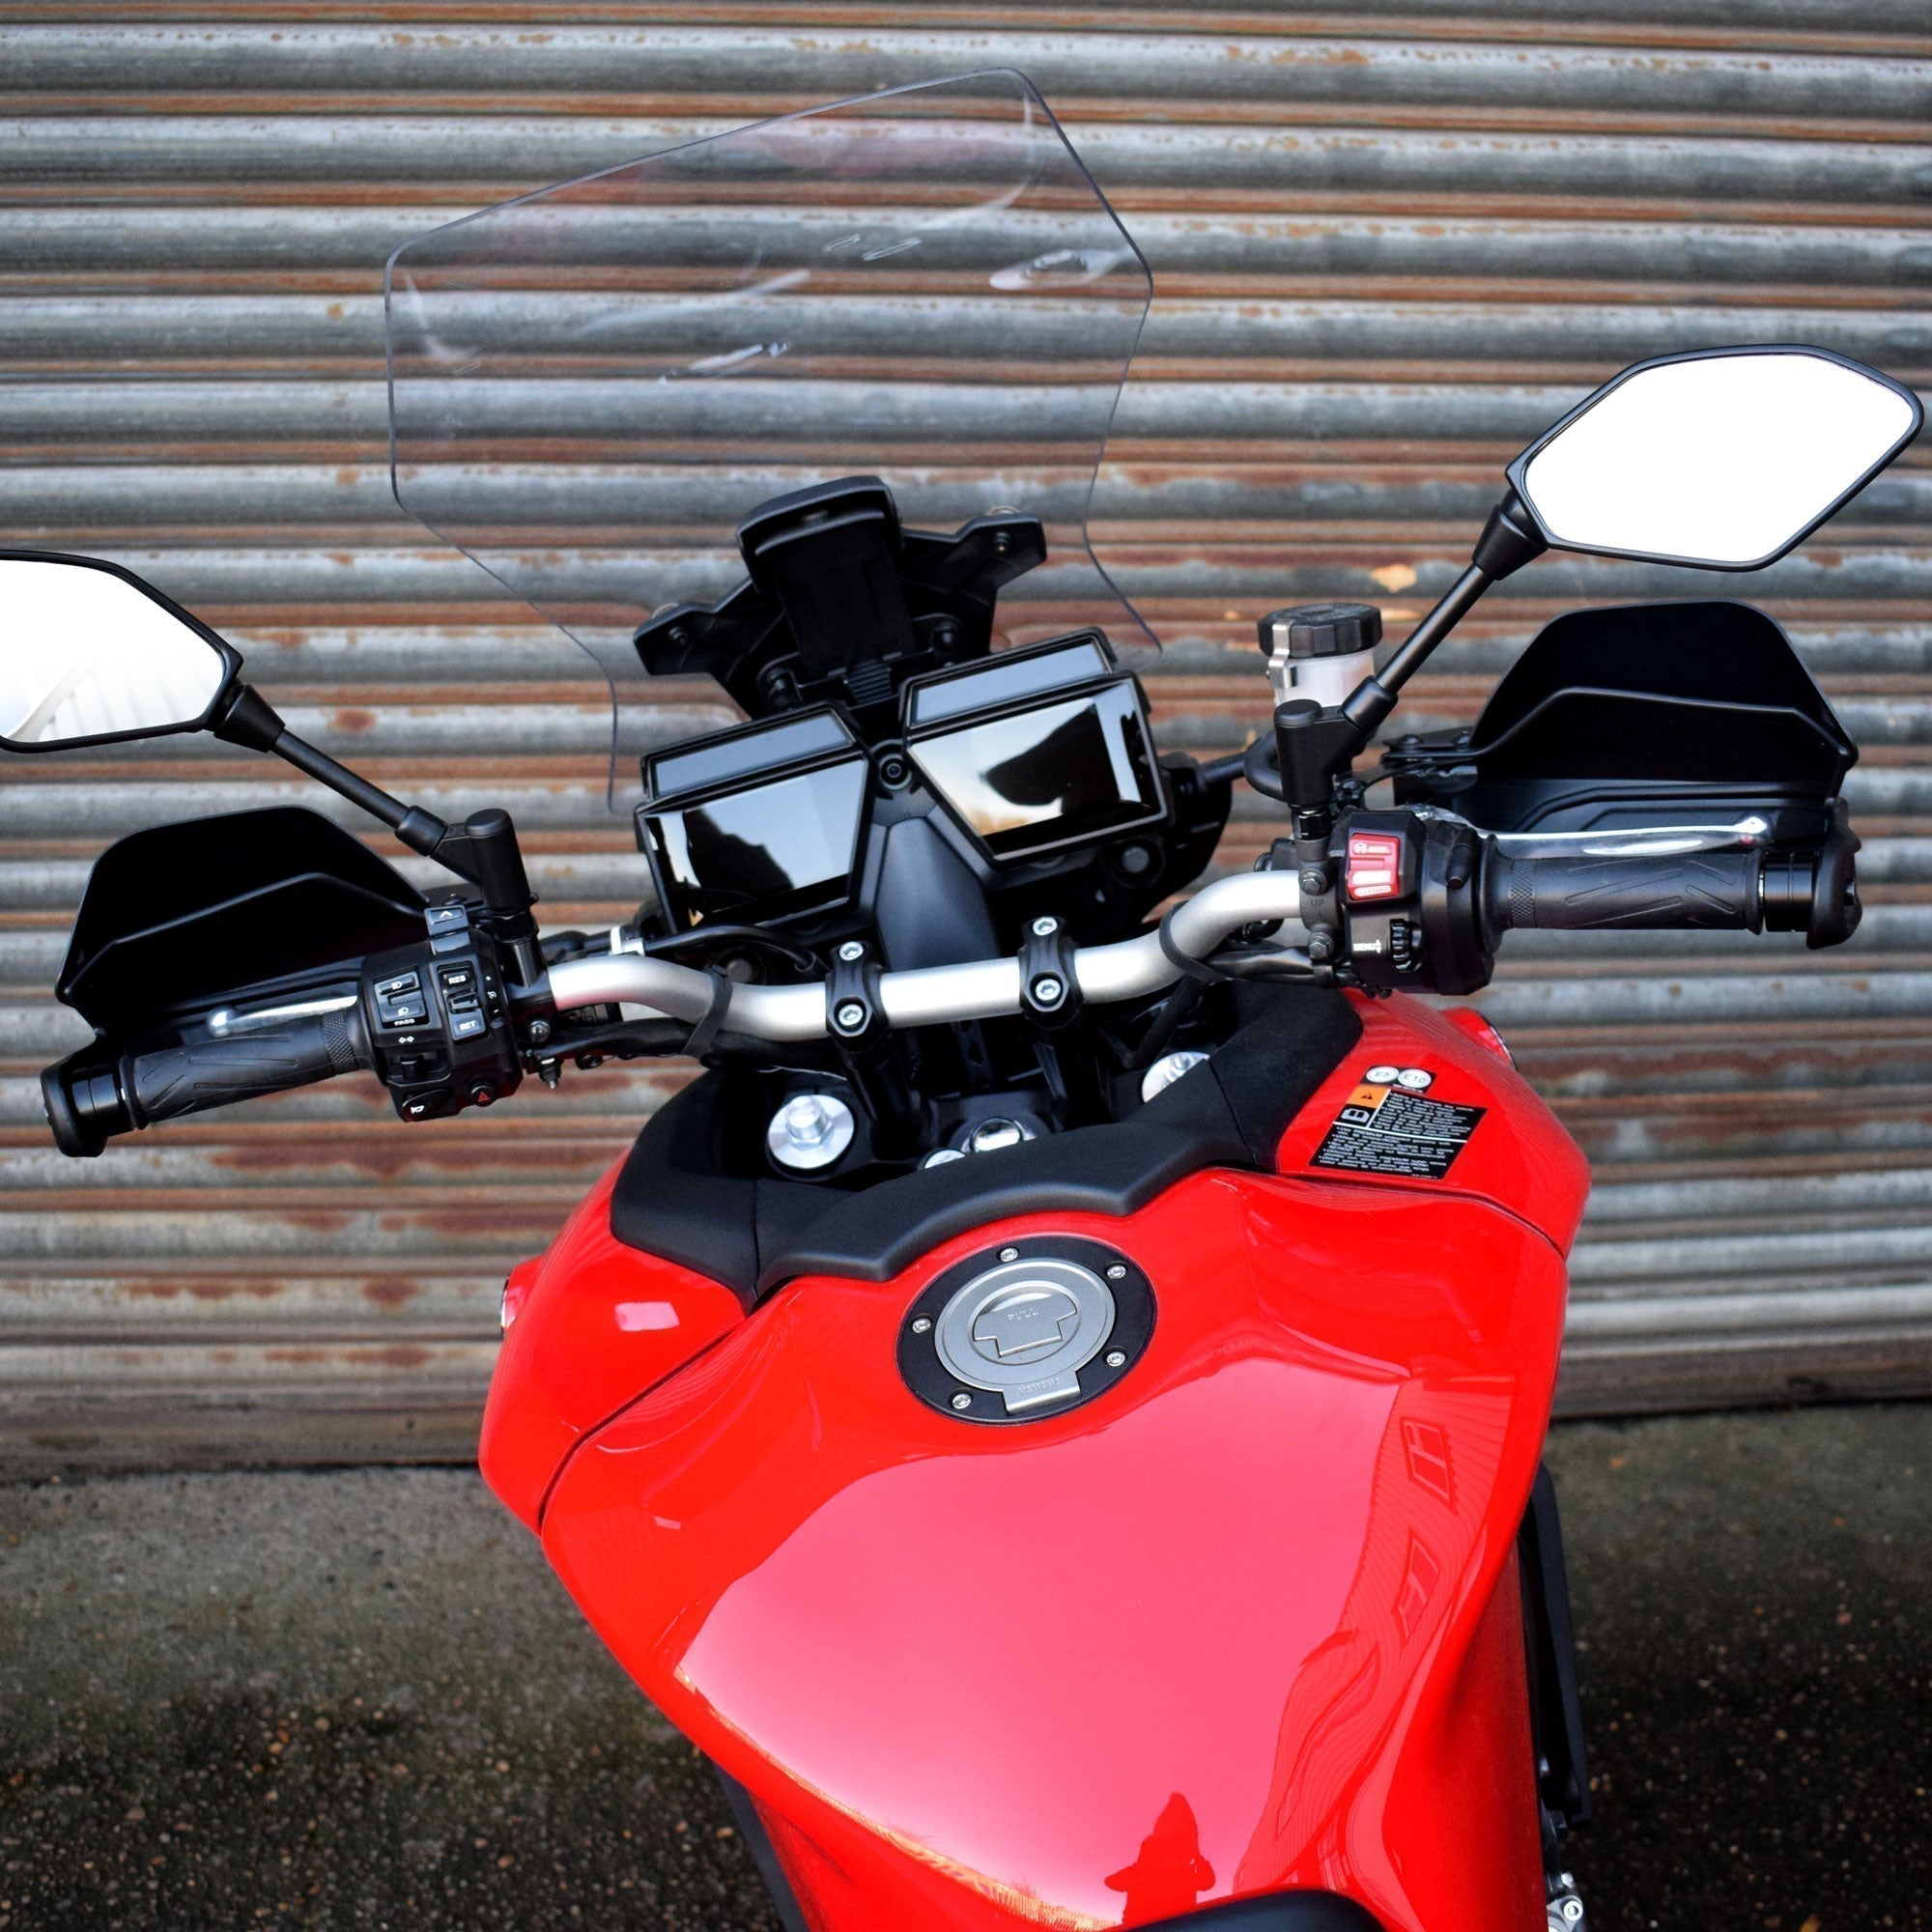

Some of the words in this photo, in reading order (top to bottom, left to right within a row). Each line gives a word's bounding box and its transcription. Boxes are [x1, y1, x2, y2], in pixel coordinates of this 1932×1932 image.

[1353, 943, 1376, 952] MENU
[448, 975, 467, 985] RES
[459, 1020, 476, 1031] SET
[1404, 1073, 1427, 1084] E10
[1007, 1308, 1039, 1321] PULL
[1018, 1377, 1061, 1397] YAMAHA
